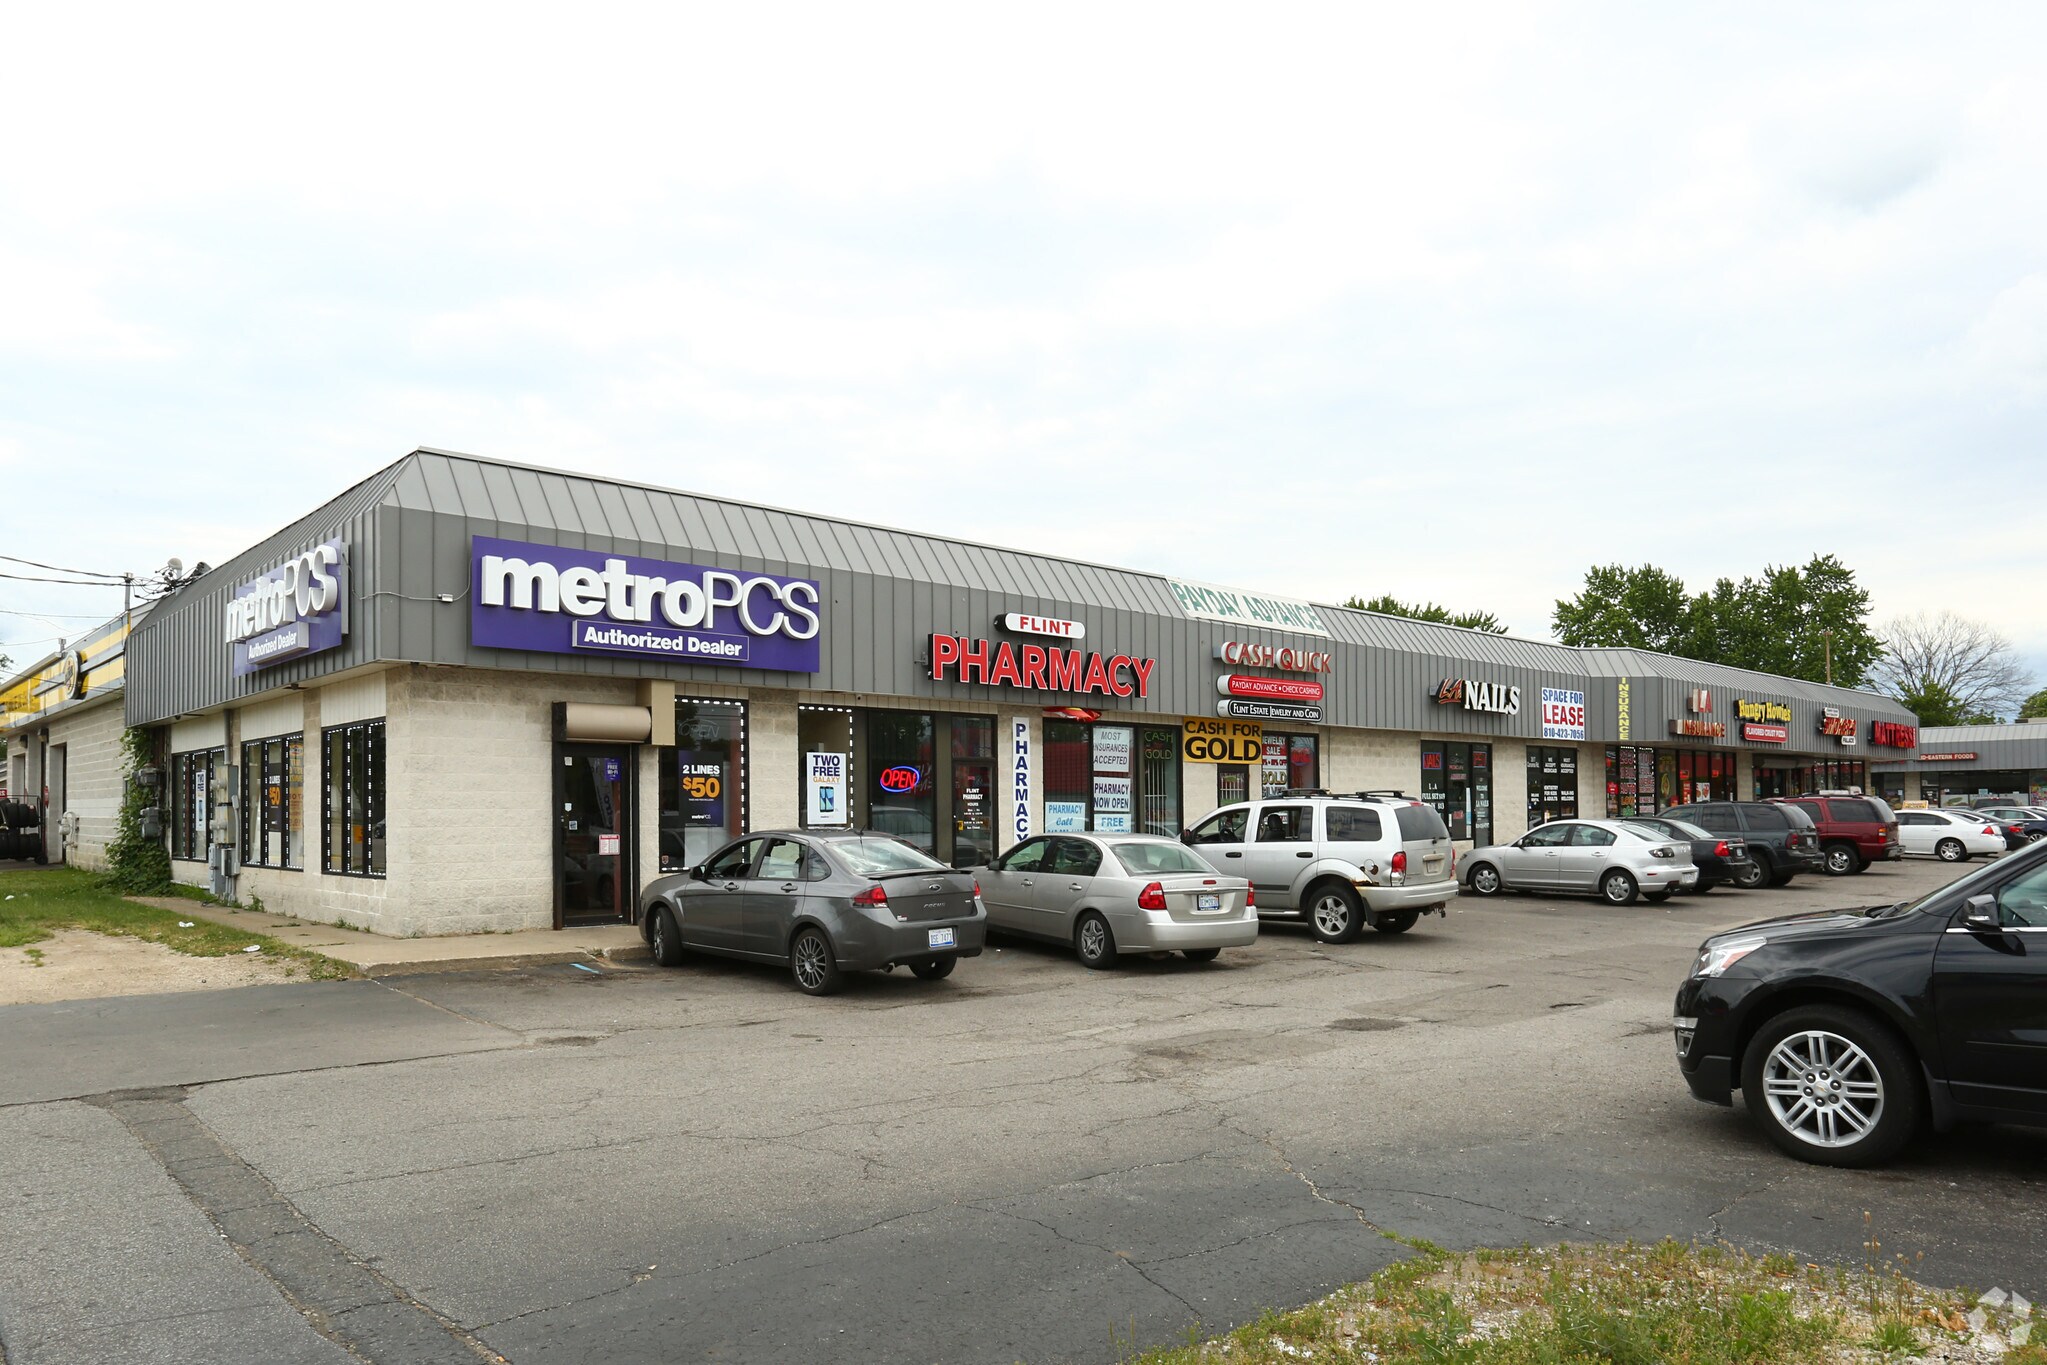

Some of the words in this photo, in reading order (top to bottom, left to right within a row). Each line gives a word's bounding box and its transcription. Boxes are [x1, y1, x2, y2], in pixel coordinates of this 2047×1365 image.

[226, 545, 337, 643] metroPCS
[481, 555, 820, 640] metroPCS
[1170, 582, 1246, 618] PAYDAY
[1242, 595, 1325, 631] ADVANCE
[1019, 616, 1072, 636] FLINT
[248, 636, 277, 659] Authorized
[278, 631, 297, 649] Dealer
[584, 626, 684, 651] Authorized
[687, 636, 742, 657] Dealer
[1222, 641, 1275, 668] CASH
[1276, 648, 1331, 673] QUICK
[930, 633, 1156, 699] PHARMACY
[1231, 680, 1253, 690] PAYDAY
[1253, 683, 1278, 692] ADVANCE
[1282, 685, 1299, 694] CHECK
[1299, 687, 1320, 696] CASHING
[1543, 689, 1568, 703] SPACE
[1569, 692, 1584, 704] FOR
[1465, 680, 1521, 715] NAILS
[1692, 689, 1713, 713] LA
[1233, 703, 1249, 714] FLINT
[1249, 704, 1268, 715] ESTATE
[1269, 706, 1292, 717] JEWELRY
[1293, 710, 1304, 718] AND
[1304, 709, 1319, 719] COIN
[1543, 704, 1584, 726] LEASE
[1618, 677, 1630, 740] INSURANCE
[1739, 699, 1765, 723] Hungry
[1101, 731, 1122, 741] MOST
[1184, 721, 1227, 735] CASH
[1232, 724, 1260, 737] FOR
[1544, 728, 1584, 740] 810-423-7056
[1677, 719, 1725, 738] INSURANCE
[1144, 748, 1173, 759] GOLD
[1184, 736, 1262, 761] GOLD
[1266, 746, 1281, 755] SALE
[813, 755, 840, 767] TWO
[1094, 755, 1128, 765] ACCEPTED
[682, 765, 690, 774] 2
[691, 764, 720, 775] LINES
[813, 766, 840, 777] FREE
[682, 776, 720, 798] $50
[881, 768, 917, 789] OPEN
[1095, 783, 1129, 795] PHARMACY
[1048, 804, 1082, 814] PHARMACY
[1094, 797, 1110, 808] NOW
[1111, 798, 1129, 809] OPEN
[1056, 816, 1073, 826] Call
[1101, 817, 1124, 827] FREE
